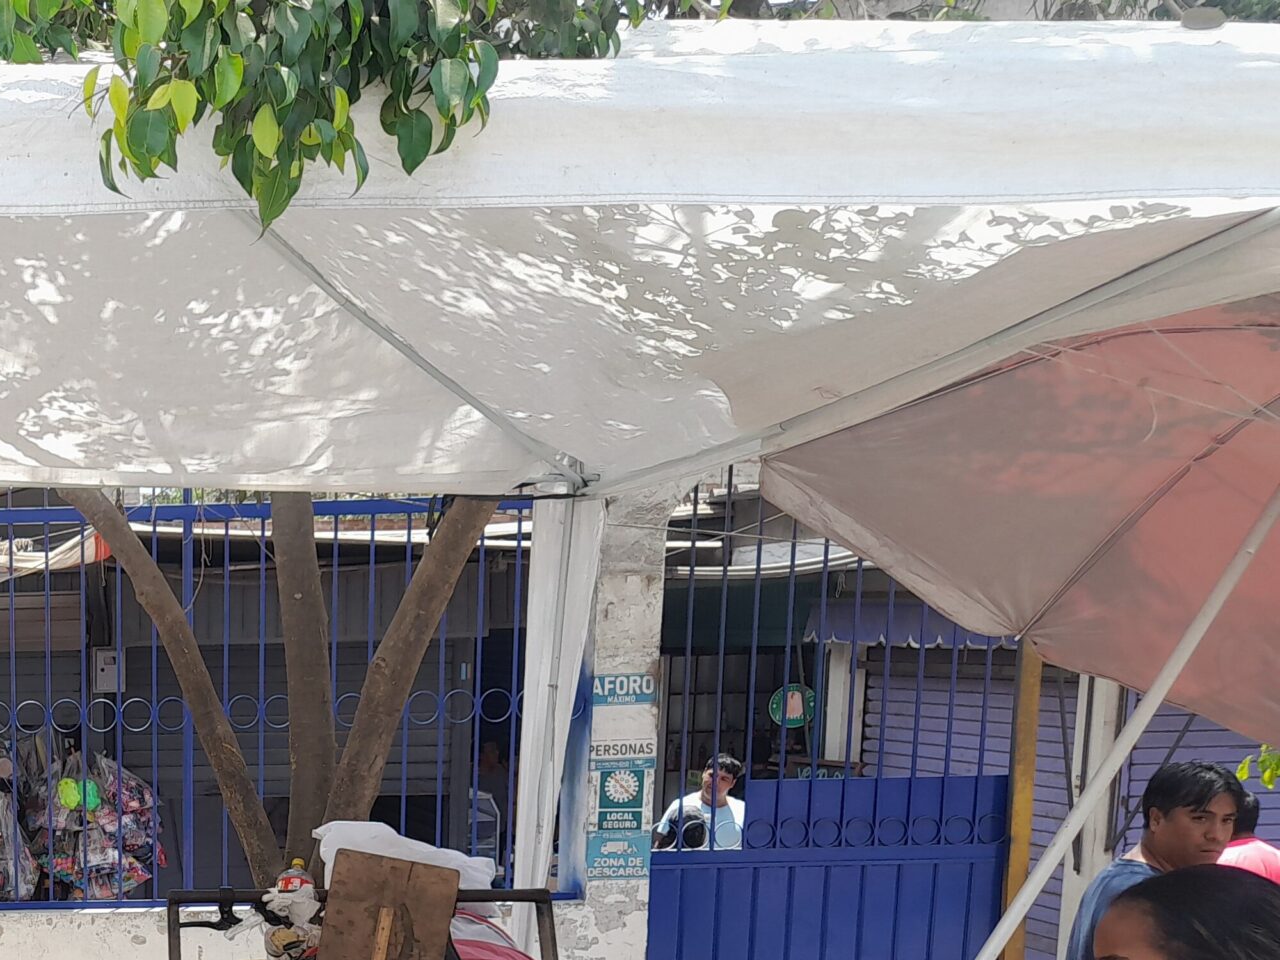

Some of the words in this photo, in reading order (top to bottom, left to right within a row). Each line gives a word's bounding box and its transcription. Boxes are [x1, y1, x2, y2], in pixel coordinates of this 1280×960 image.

[593, 676, 655, 696] AFORO
[607, 694, 636, 703] MÁXIMO
[590, 742, 655, 757] PERSONAS
[606, 812, 634, 820] LOCAL
[602, 820, 637, 829] SEGURO
[593, 857, 625, 867] ZONA
[627, 857, 644, 866] DE
[587, 867, 648, 877] DESCARGA
